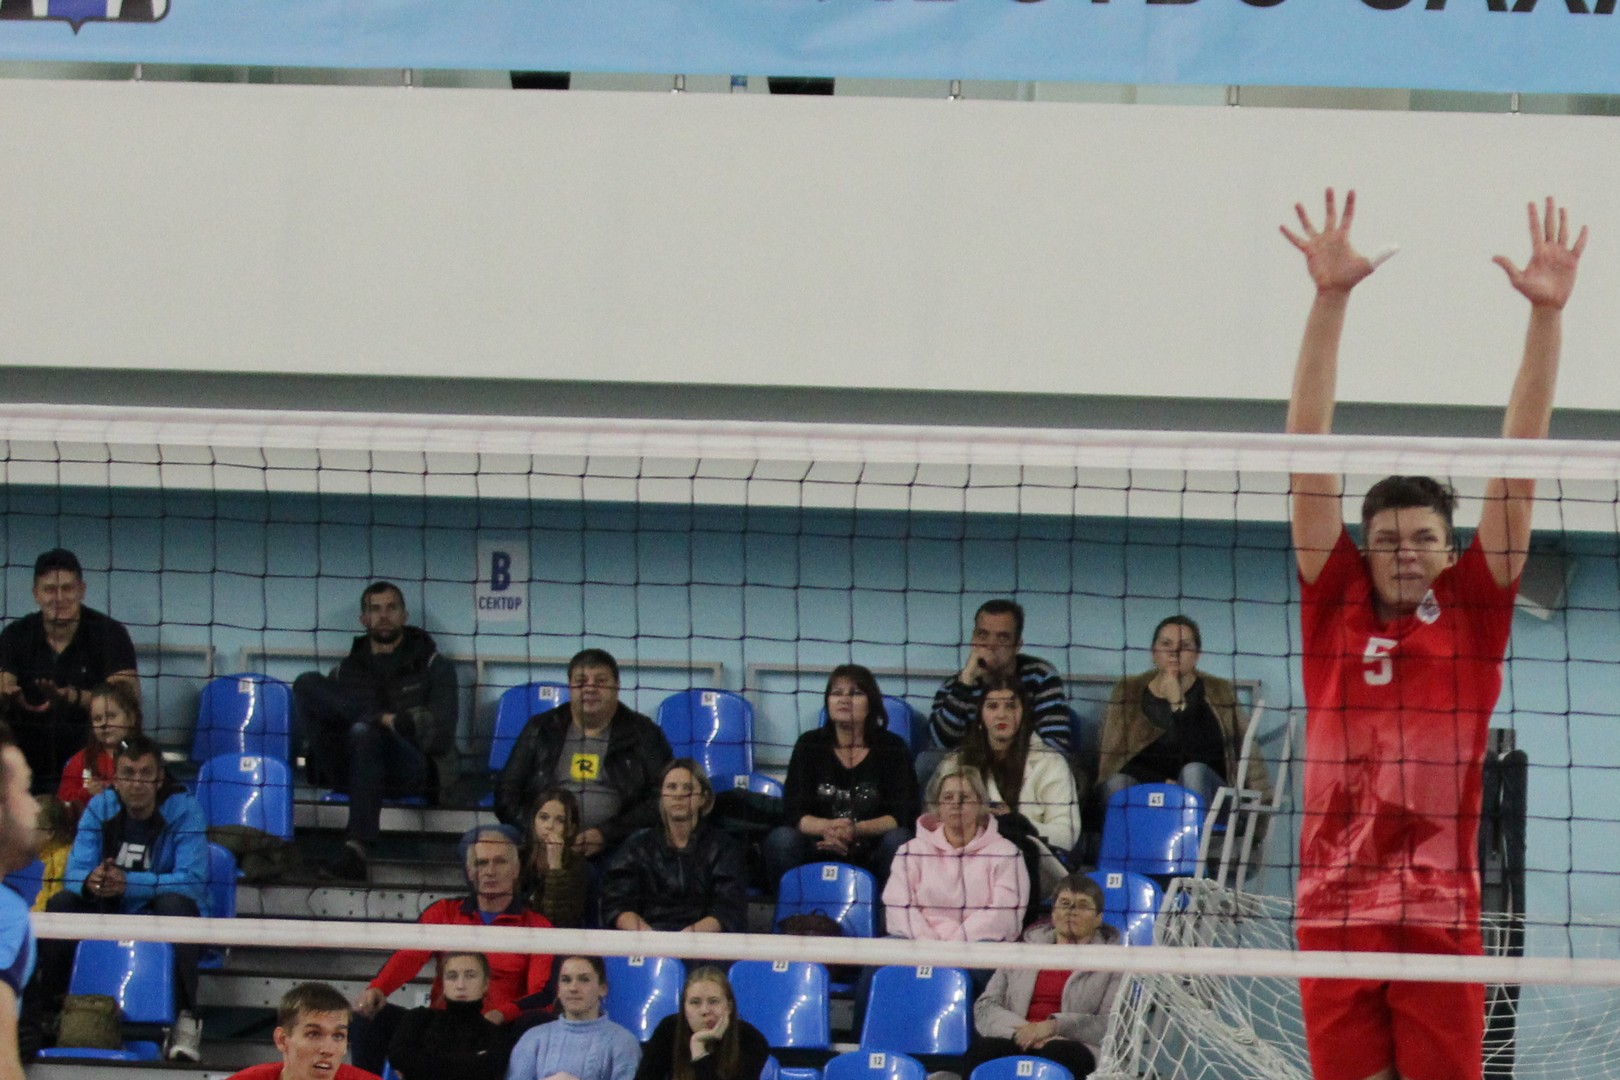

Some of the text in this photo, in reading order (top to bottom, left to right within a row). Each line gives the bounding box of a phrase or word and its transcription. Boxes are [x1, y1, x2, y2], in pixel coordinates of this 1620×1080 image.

[490, 551, 511, 592] В
[478, 596, 523, 611] СЕКТОР
[1362, 637, 1399, 686] 5
[873, 1056, 883, 1066] 12
[1020, 1064, 1030, 1073] 11
